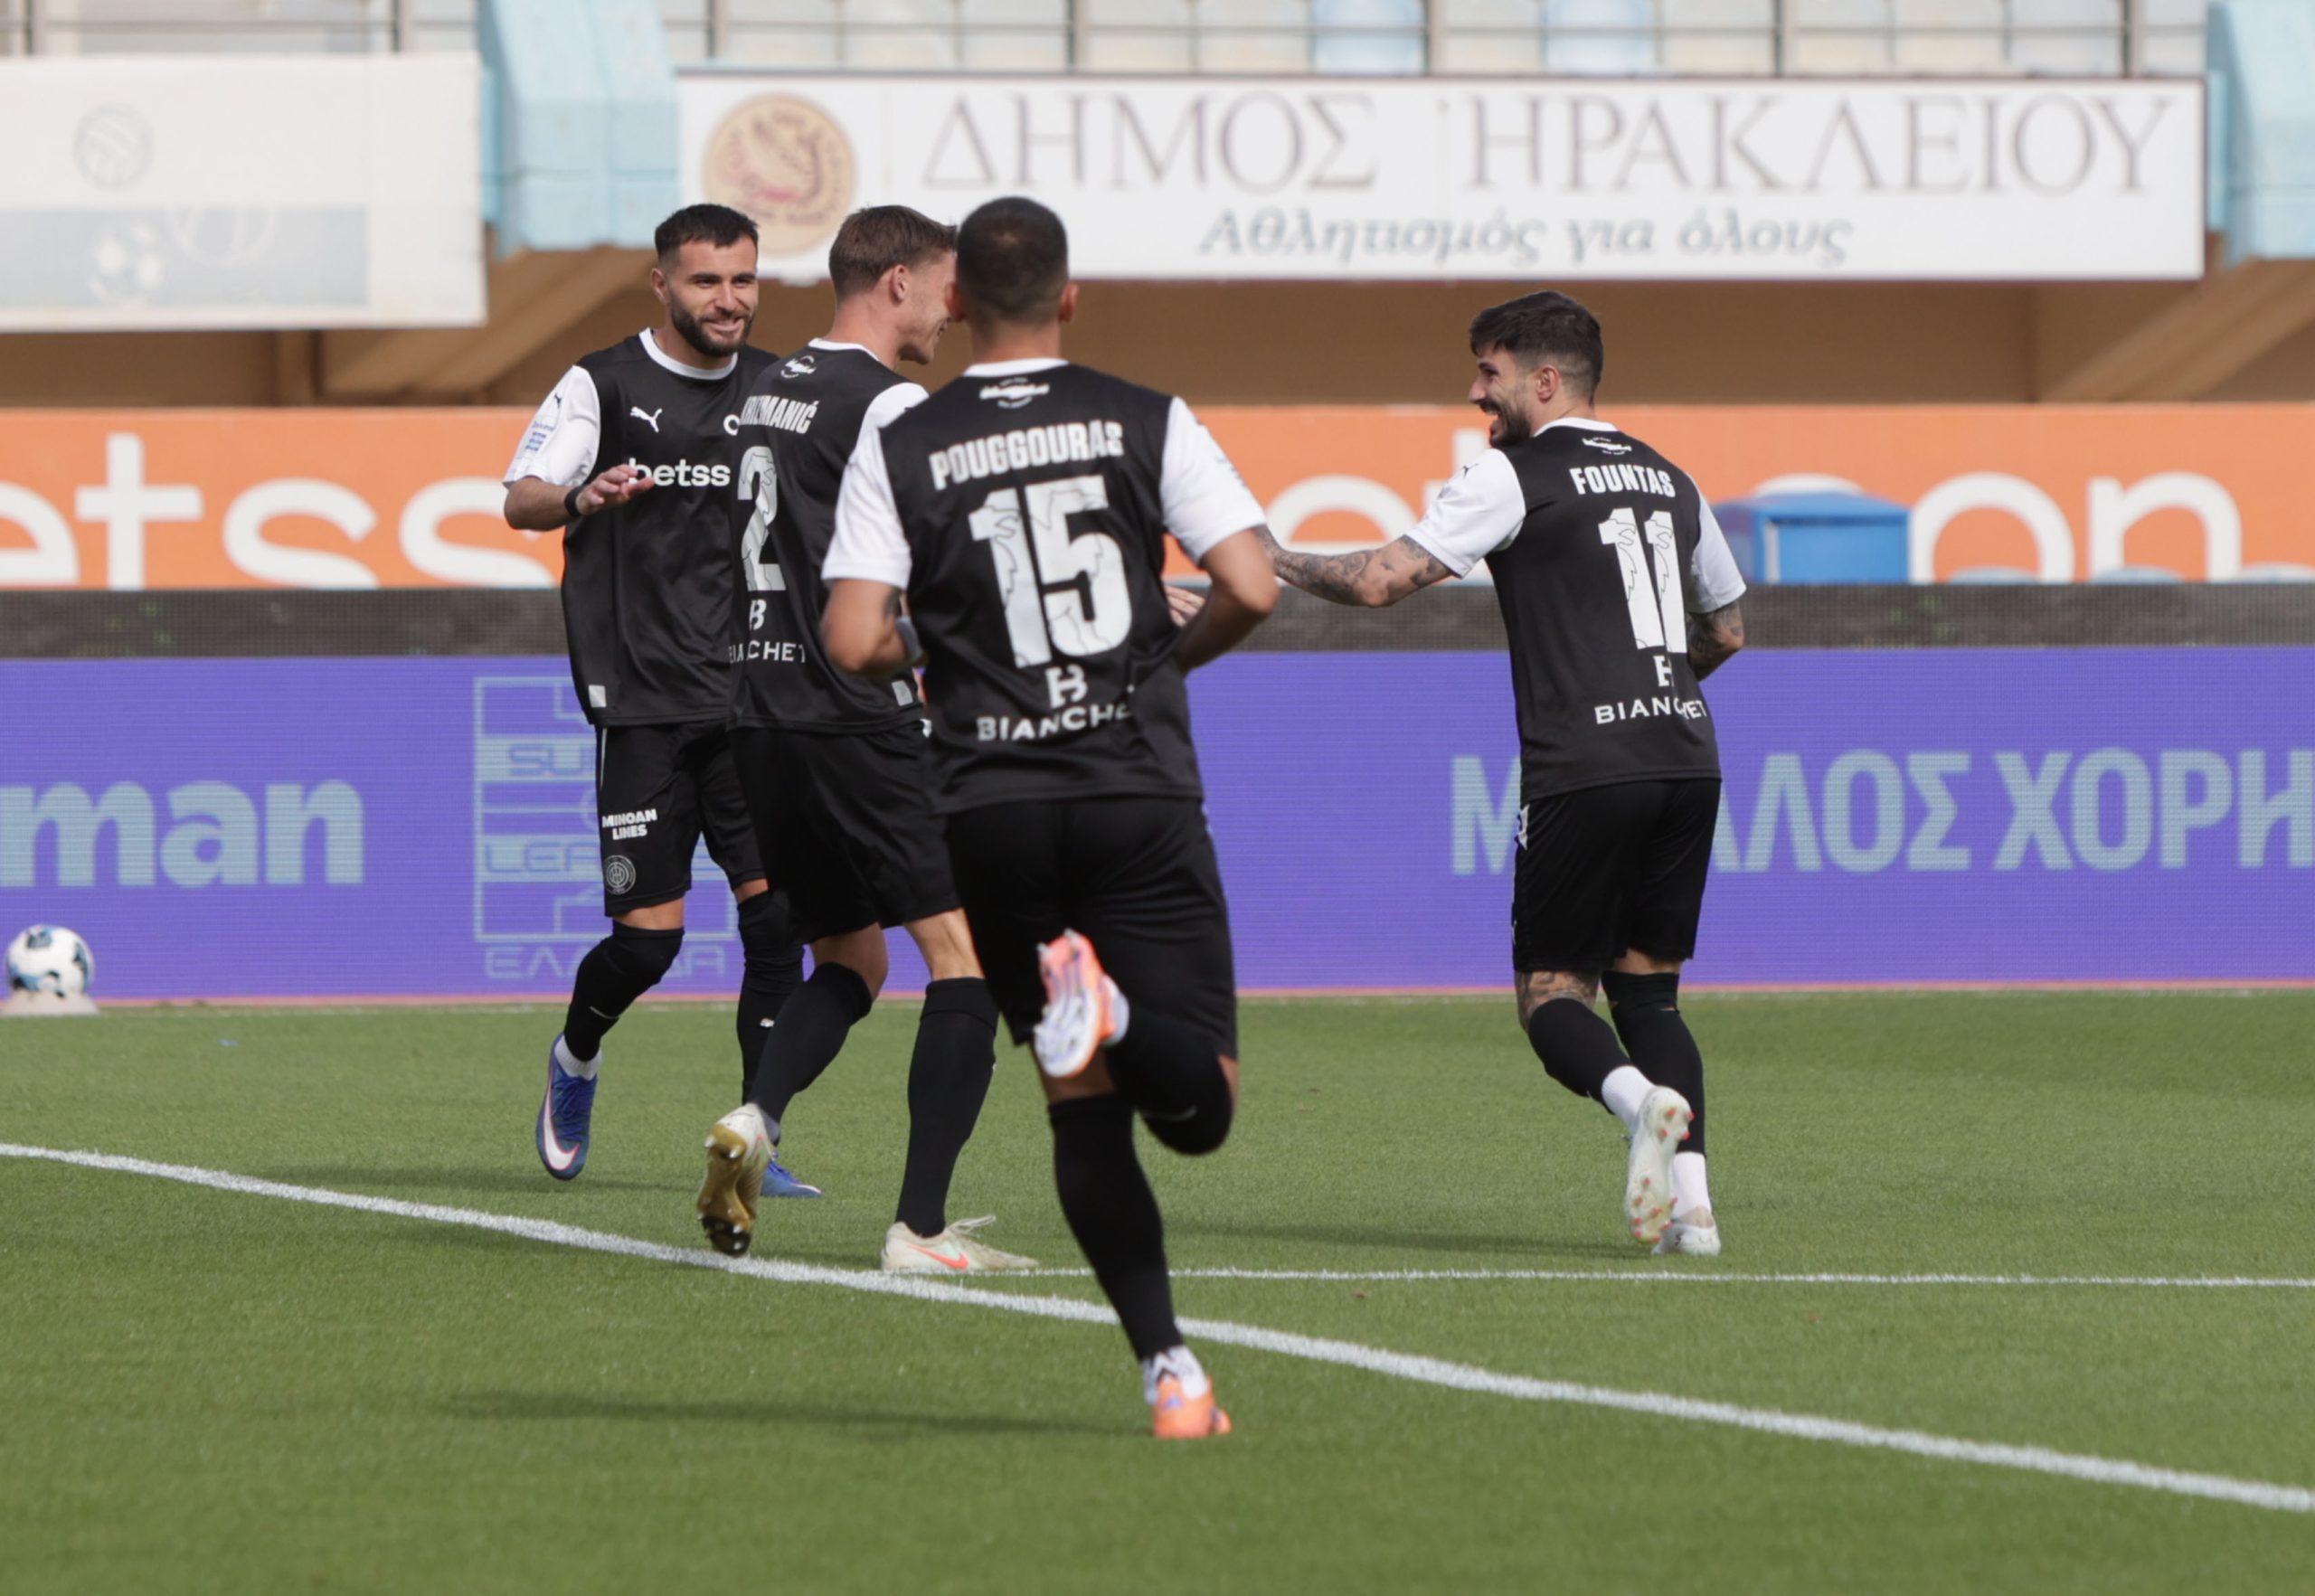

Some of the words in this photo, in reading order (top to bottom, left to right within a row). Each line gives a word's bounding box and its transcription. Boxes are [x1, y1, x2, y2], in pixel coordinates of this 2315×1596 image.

[921, 90, 1377, 192] ΔΗΜΟΣ
[1197, 204, 1548, 266] Αθλητισμός
[1566, 218, 1656, 264] για
[1677, 207, 1853, 265] όλους
[929, 419, 1125, 490] POUGGOURAS
[1569, 464, 1676, 497] FOUNTAS
[737, 446, 786, 591] 2
[968, 475, 1132, 668] 15
[1598, 507, 1687, 653] 11
[0, 779, 366, 889] man
[601, 808, 657, 827] MINOAN
[612, 824, 647, 840] LINES
